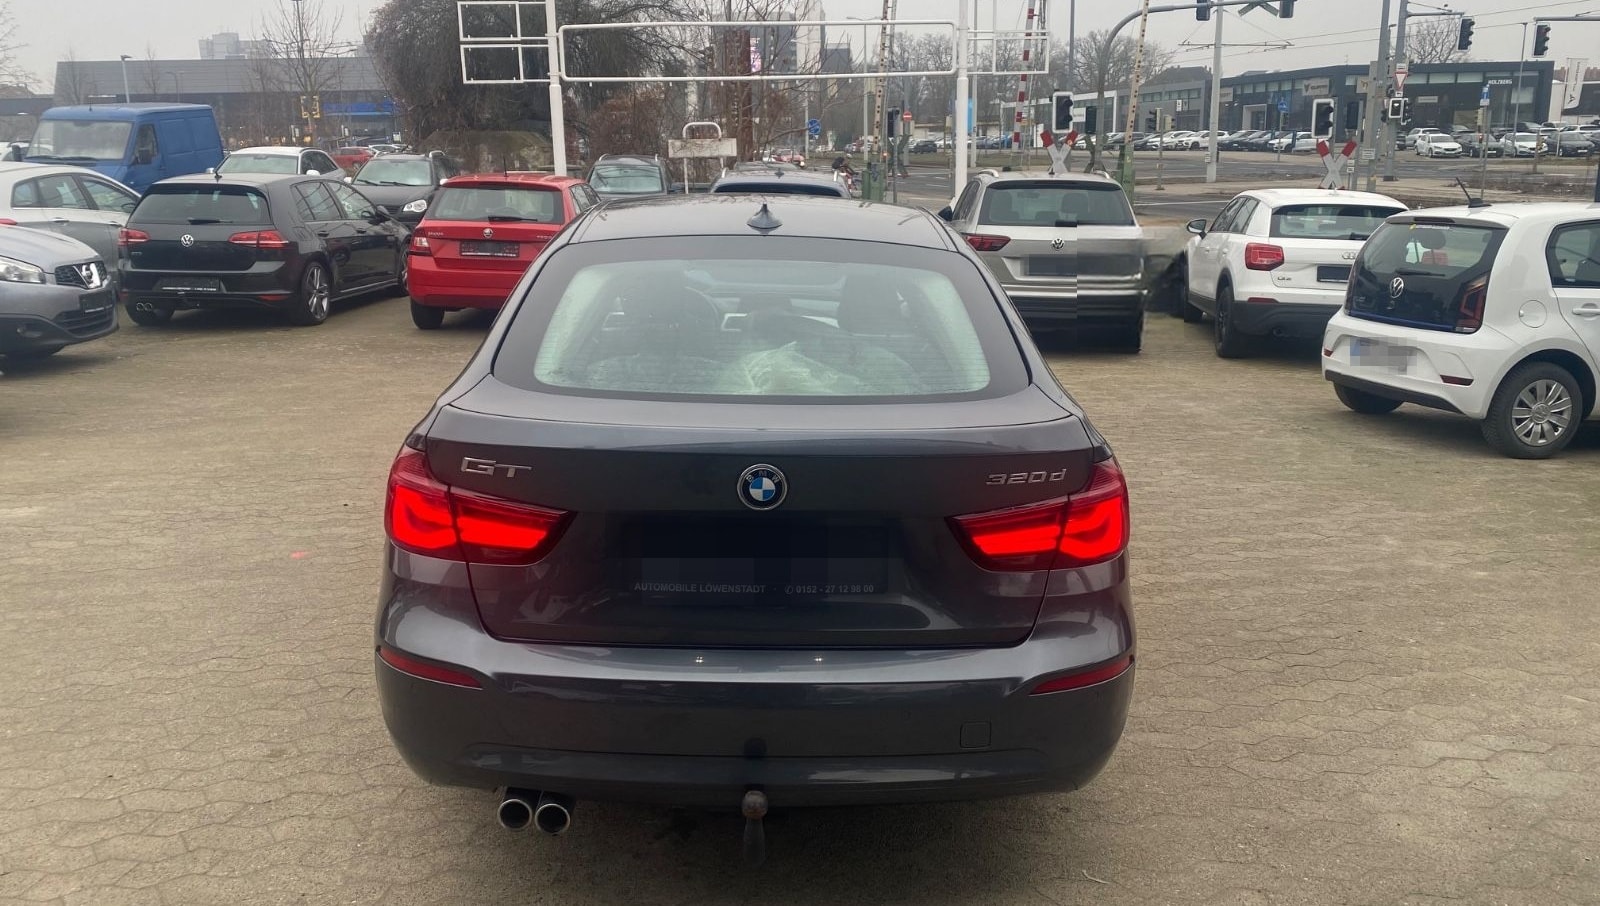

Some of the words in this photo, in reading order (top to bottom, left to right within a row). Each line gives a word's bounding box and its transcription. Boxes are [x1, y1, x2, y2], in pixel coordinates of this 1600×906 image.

[461, 457, 532, 478] GT
[746, 470, 780, 483] BMW
[986, 468, 1067, 485] 320d
[633, 582, 697, 592] AUTOMOBILE
[699, 582, 766, 593] LÖWENSTADT
[795, 584, 817, 593] 0152
[825, 584, 836, 593] 27
[838, 584, 849, 593] 12
[850, 584, 861, 593] 98
[863, 584, 874, 593] 00
